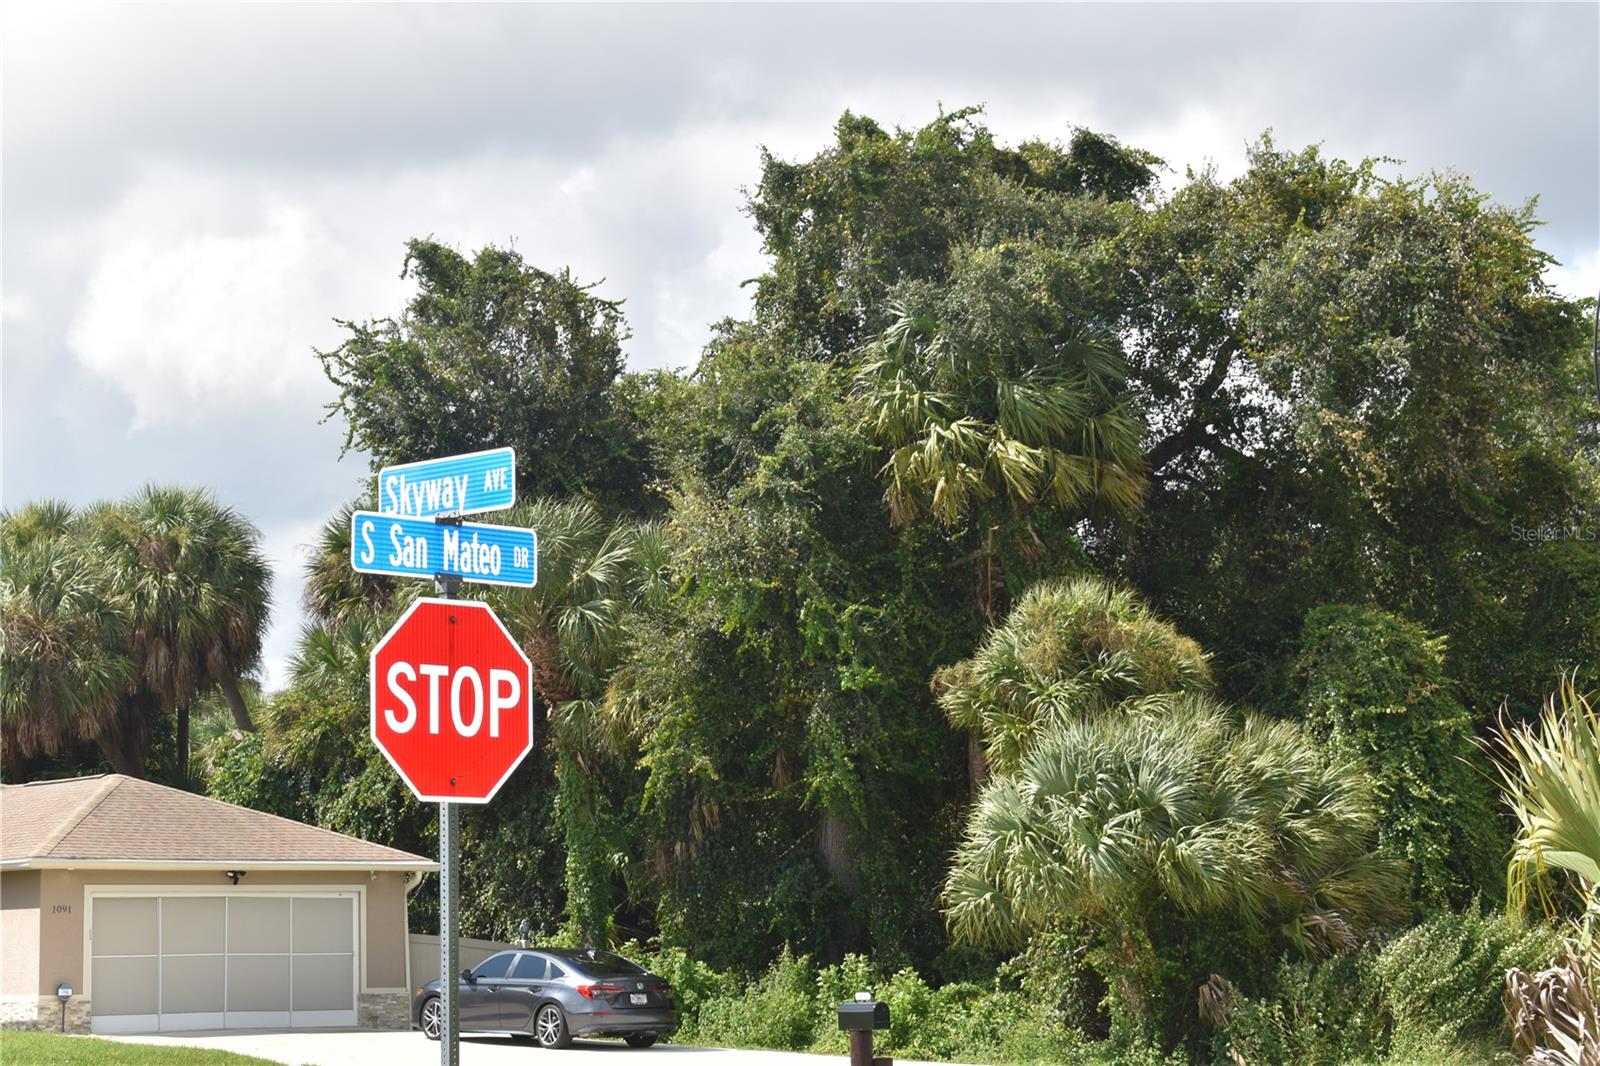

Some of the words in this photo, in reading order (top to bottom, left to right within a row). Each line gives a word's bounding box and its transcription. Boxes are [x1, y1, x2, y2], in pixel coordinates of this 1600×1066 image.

[385, 473, 469, 518] Skyway
[483, 466, 508, 492] AVE
[360, 520, 375, 565] S
[388, 523, 428, 569] San
[443, 528, 501, 576] Mateo
[513, 546, 529, 568] DR
[384, 660, 521, 738] STOP
[52, 904, 72, 914] 1091
